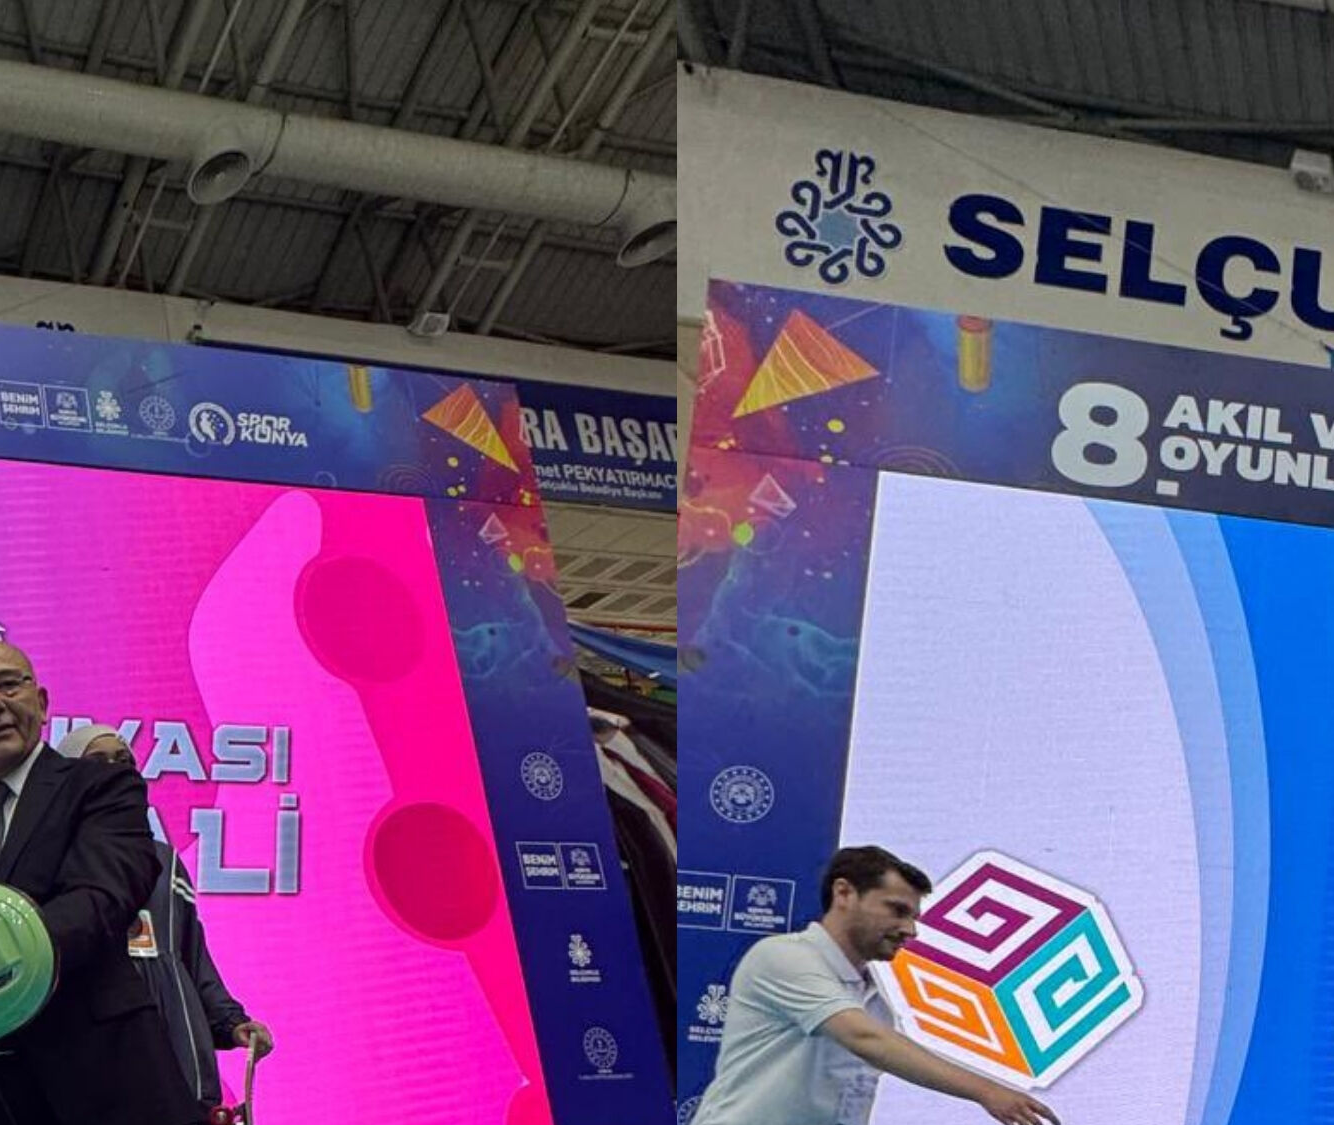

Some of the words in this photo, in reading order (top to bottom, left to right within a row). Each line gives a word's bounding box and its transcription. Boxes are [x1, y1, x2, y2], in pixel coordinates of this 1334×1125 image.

[236, 412, 292, 434] SPOR
[1051, 382, 1179, 497] 8.
[1162, 395, 1293, 444] AKIL
